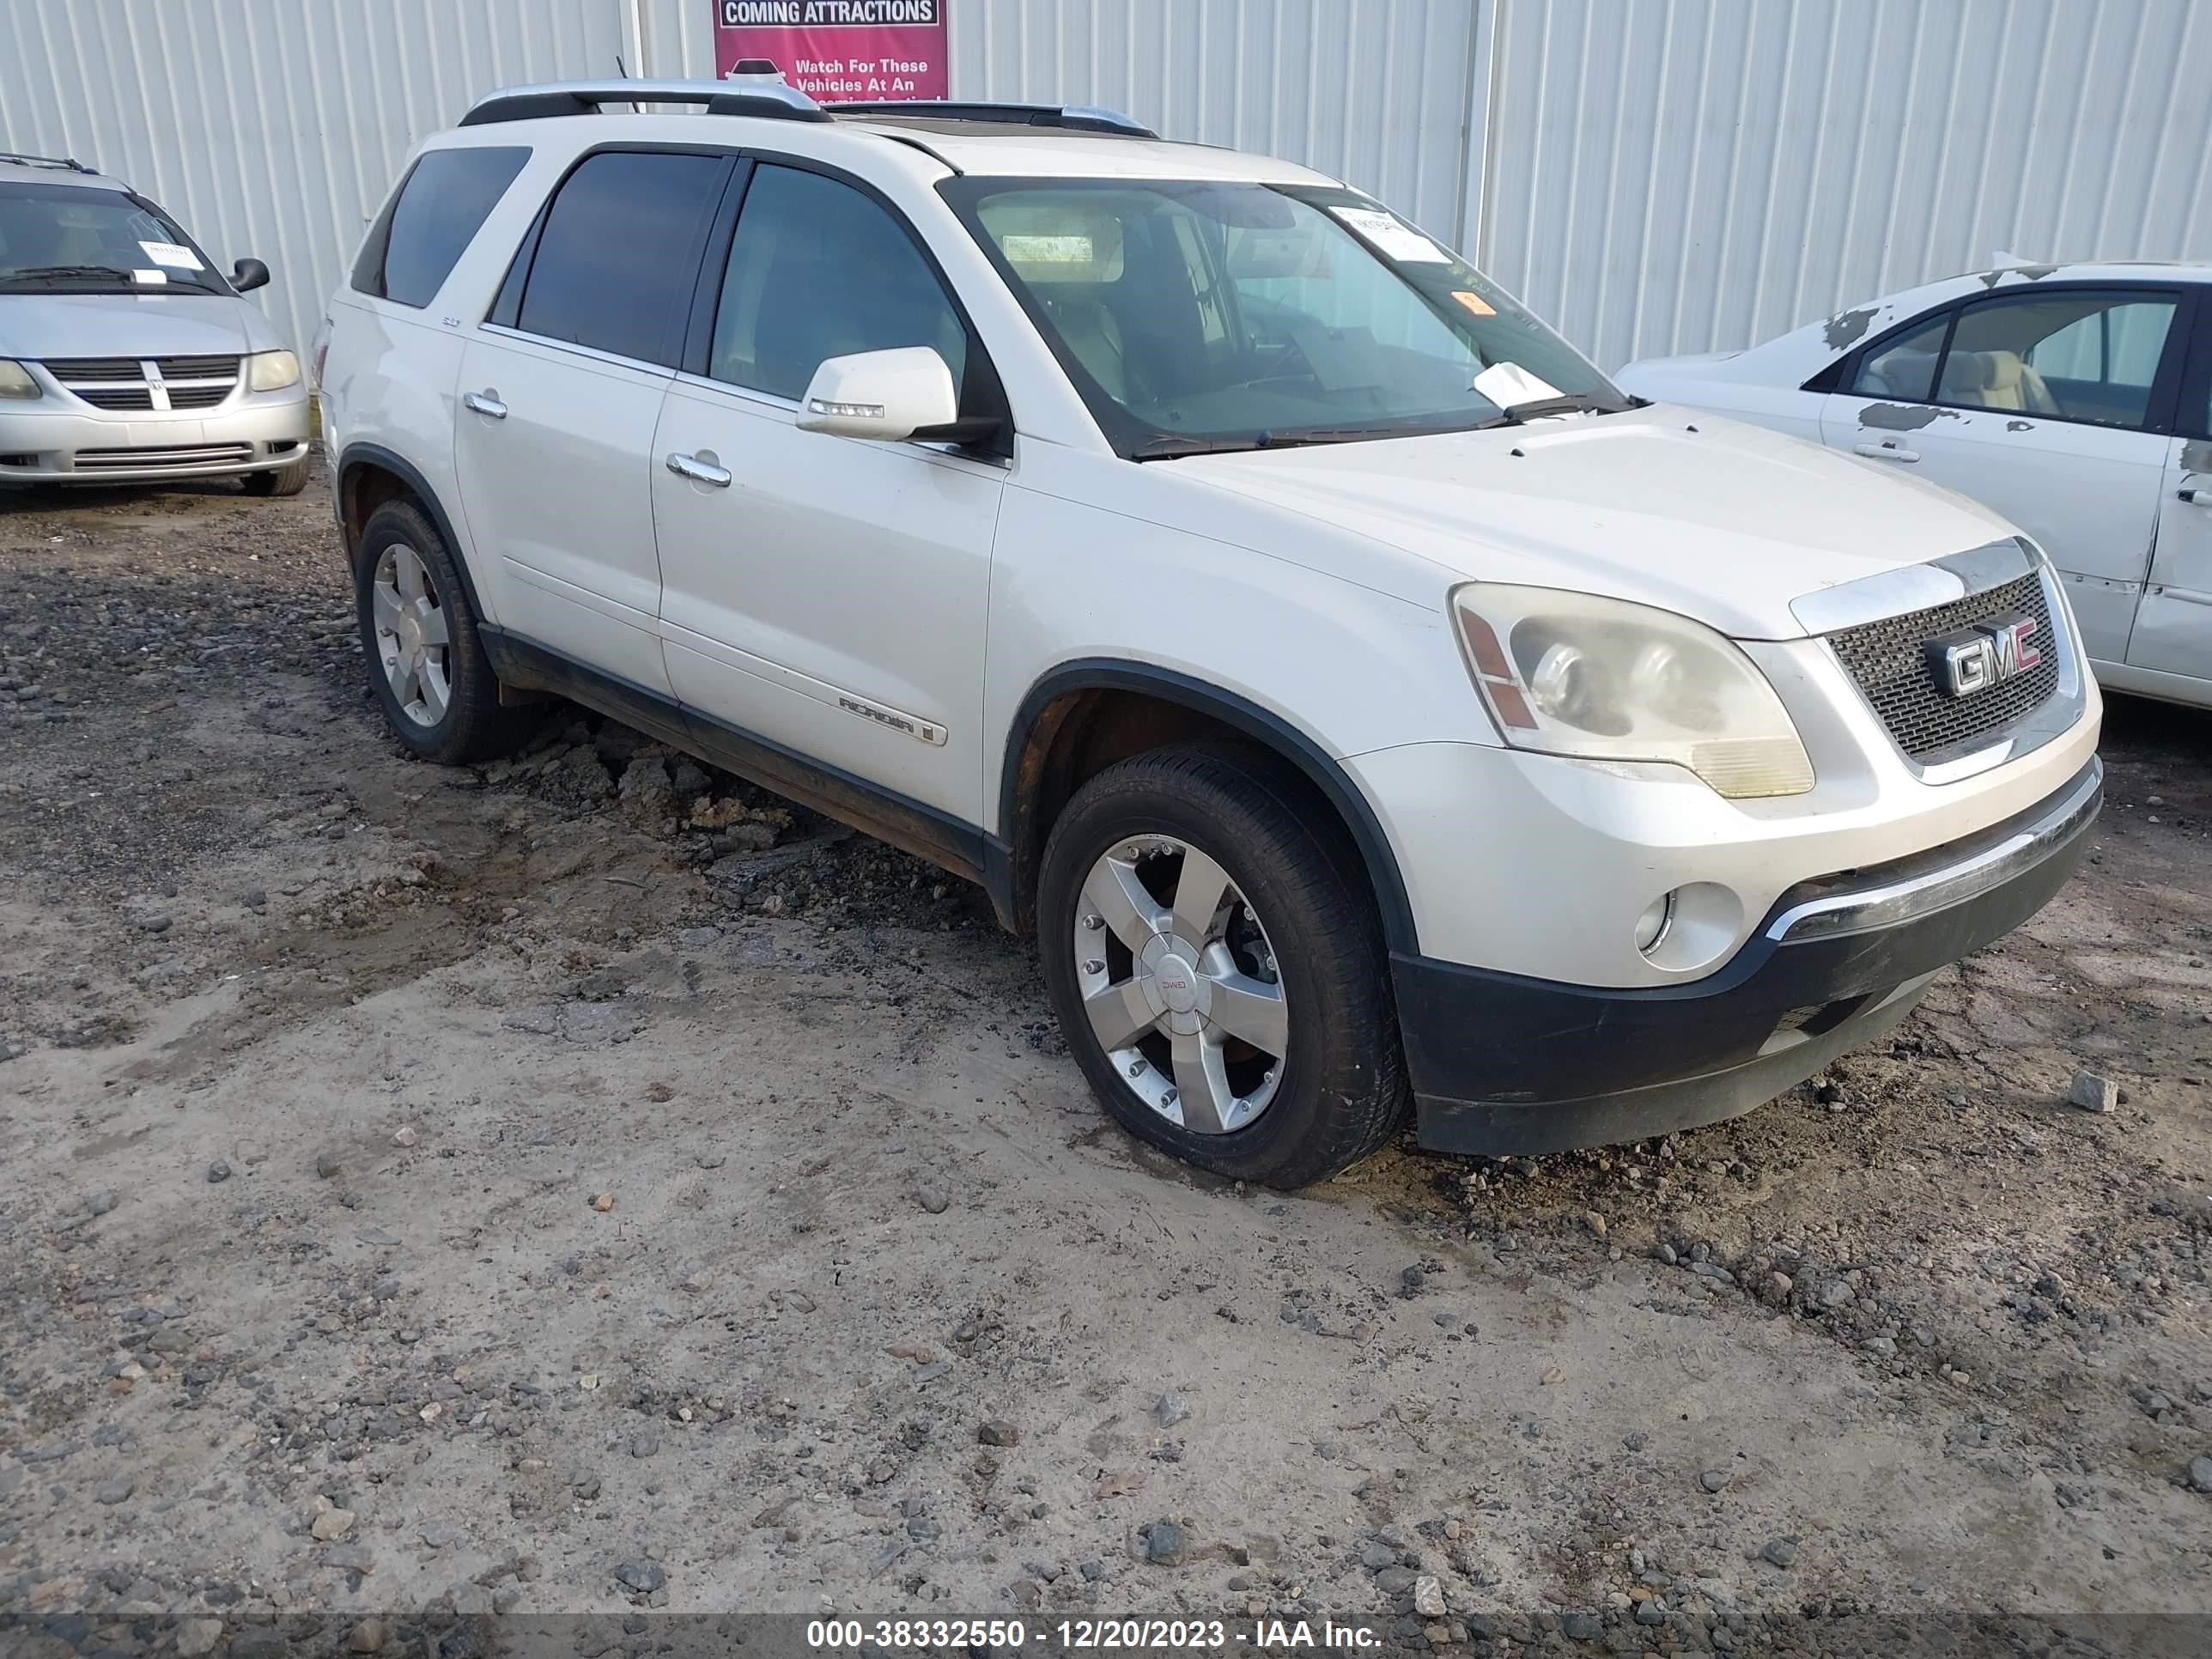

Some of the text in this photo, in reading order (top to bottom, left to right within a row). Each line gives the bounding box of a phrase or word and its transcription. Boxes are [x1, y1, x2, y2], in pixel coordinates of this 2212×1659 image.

[726, 0, 933, 23] COMING ATTRACTIONS
[795, 58, 928, 74] Watch For These
[796, 77, 915, 92] Vehicles At An
[1947, 617, 2041, 696] GMC
